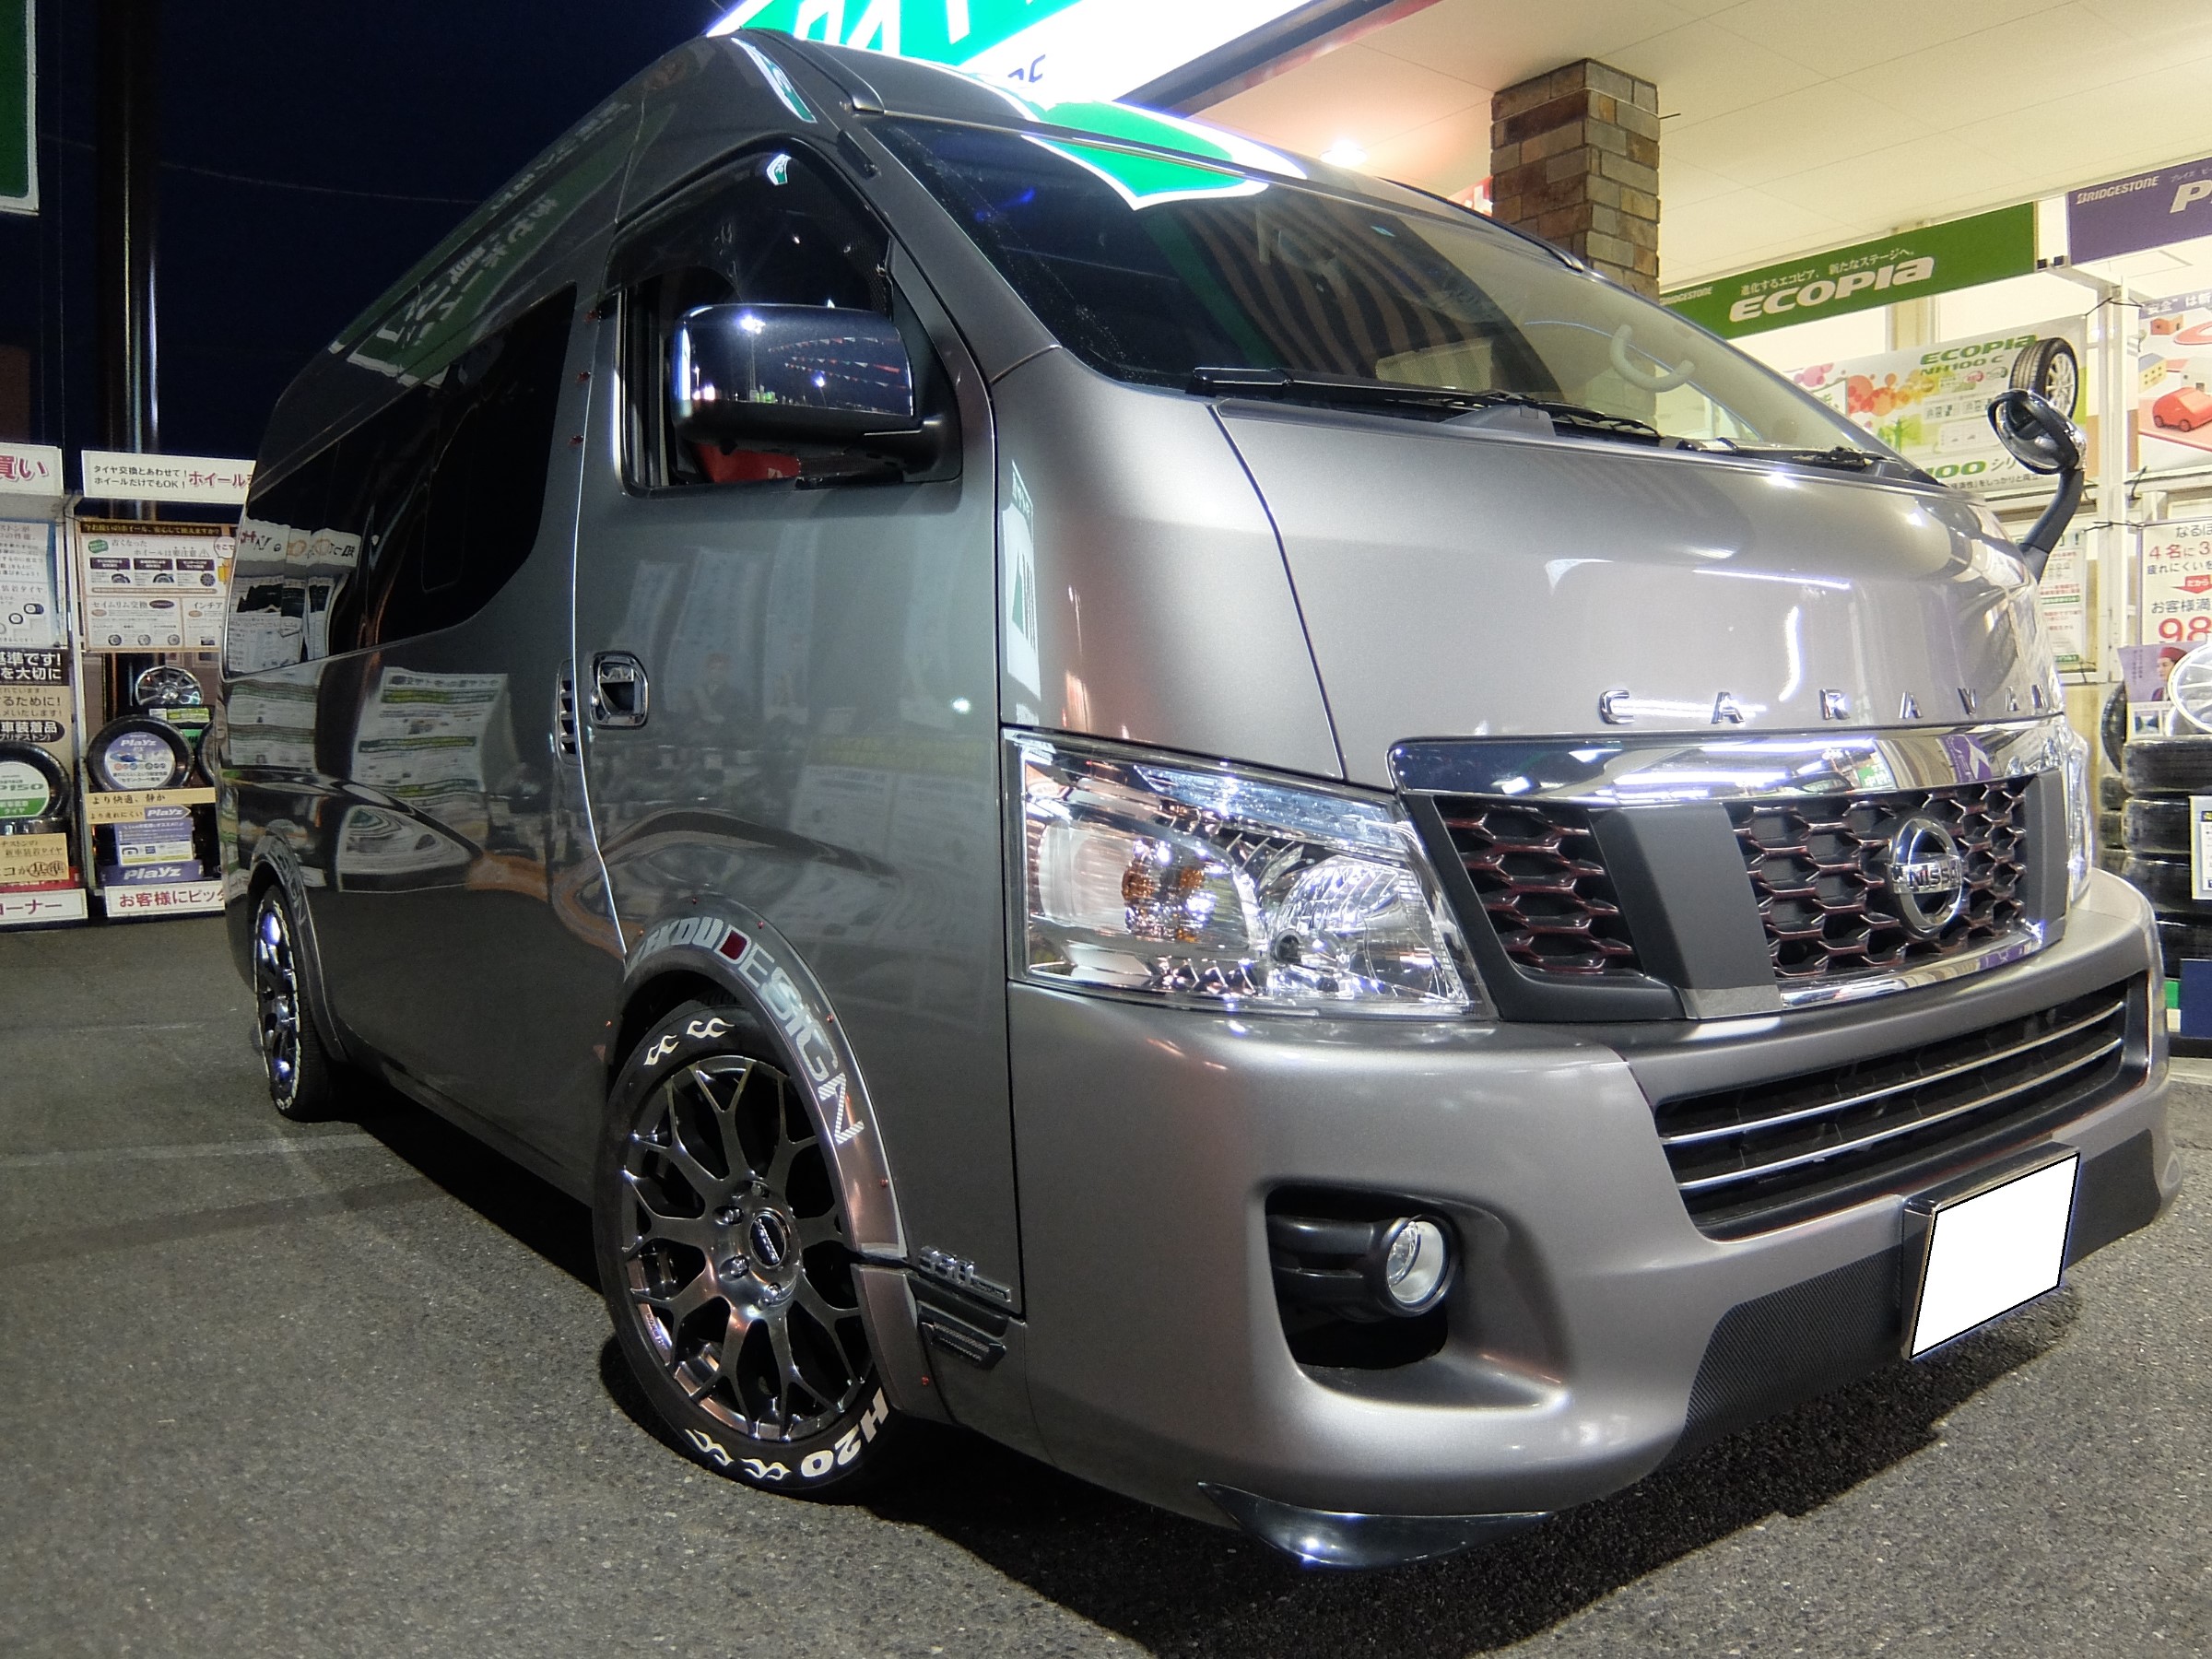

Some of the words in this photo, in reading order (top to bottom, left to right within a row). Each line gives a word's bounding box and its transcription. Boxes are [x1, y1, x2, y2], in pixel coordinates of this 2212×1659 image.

[2077, 175, 2160, 206] BRIDGESTONE
[1598, 686, 2047, 725] CARAVAN
[1908, 858, 1960, 887] NISSA
